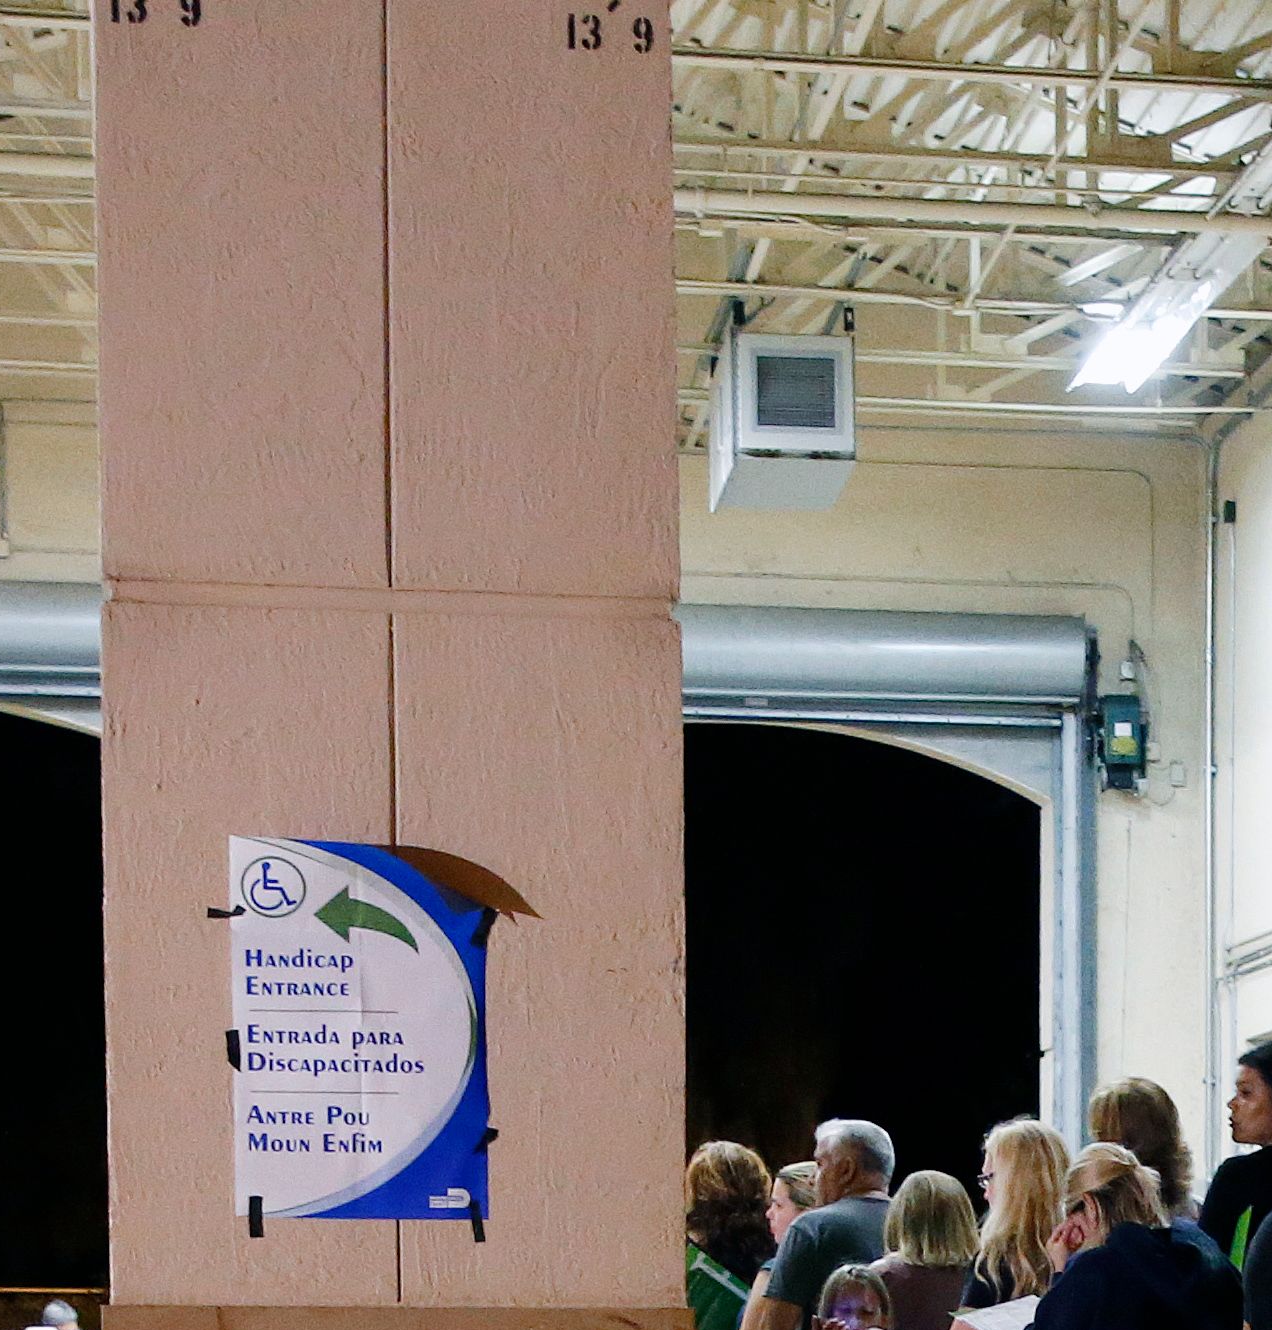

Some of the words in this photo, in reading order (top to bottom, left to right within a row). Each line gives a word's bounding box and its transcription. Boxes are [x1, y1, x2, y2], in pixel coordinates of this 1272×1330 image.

[245, 948, 354, 973] Handicap
[246, 976, 350, 996] Entrance
[247, 1024, 340, 1044] Entrada
[352, 1031, 405, 1050] para
[248, 1052, 425, 1077] Discapacitados
[247, 1104, 315, 1125] Antre
[327, 1106, 370, 1126] Pou
[248, 1133, 310, 1153] Moun
[323, 1132, 383, 1153] Enfim
